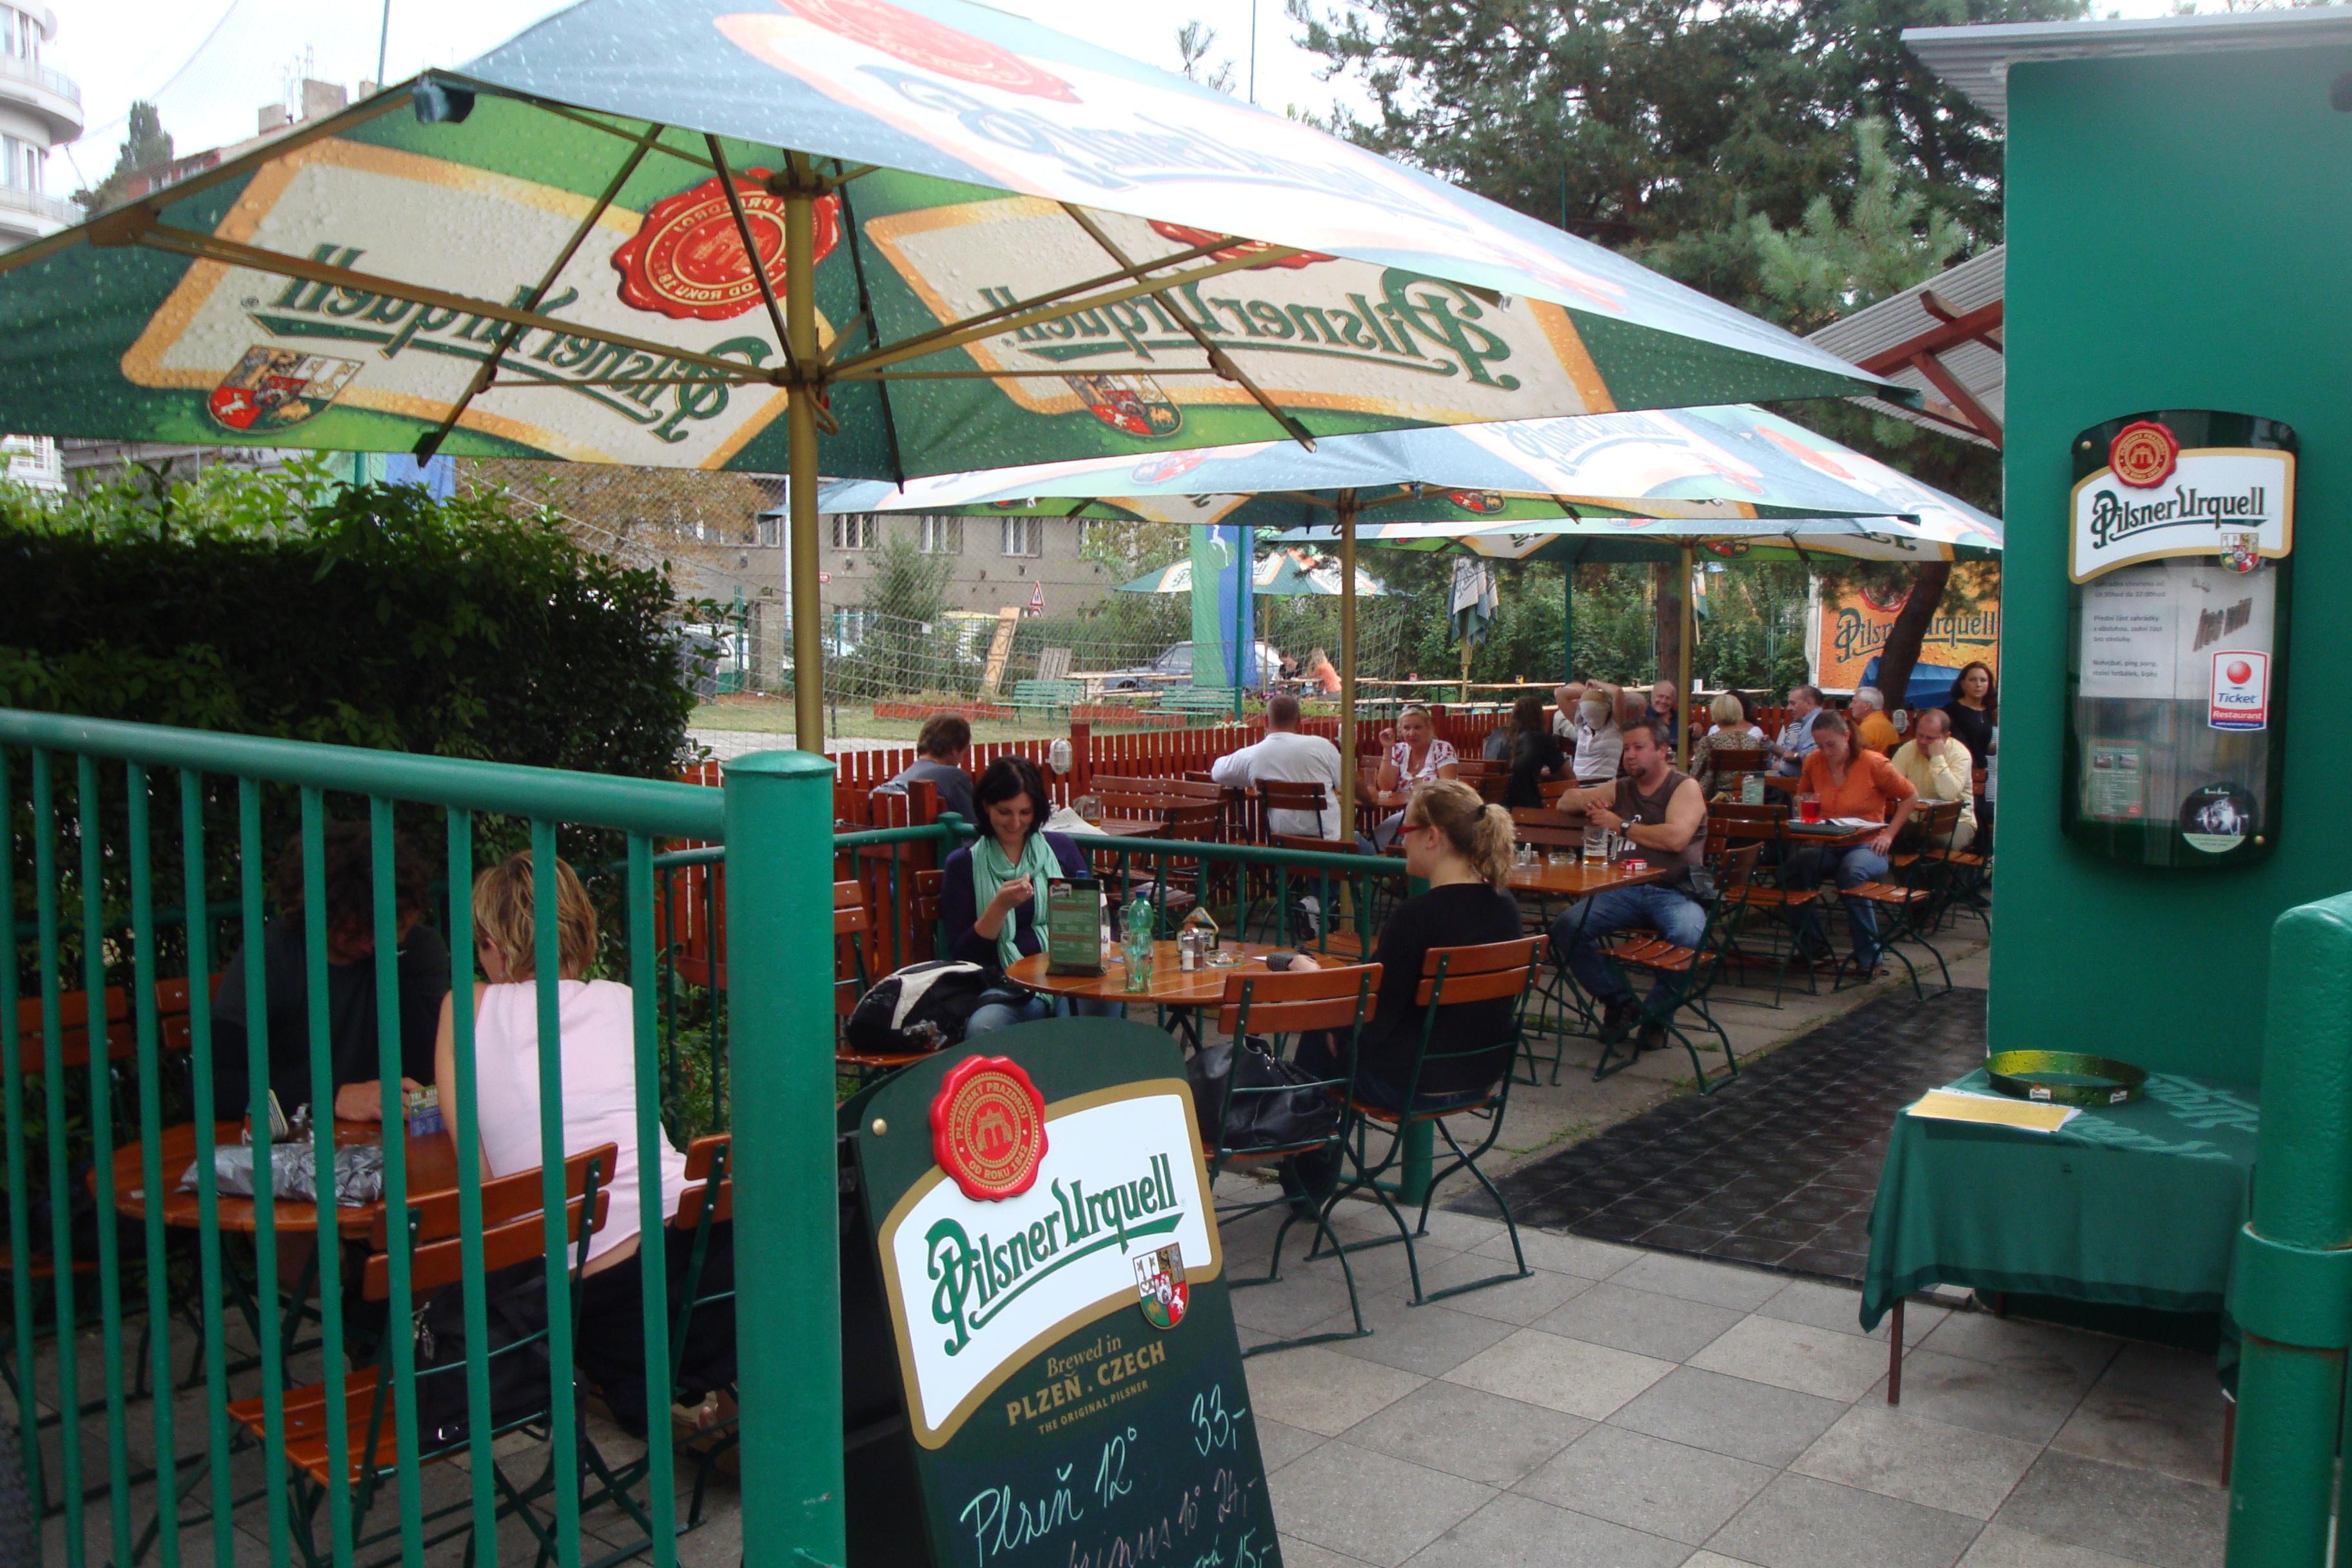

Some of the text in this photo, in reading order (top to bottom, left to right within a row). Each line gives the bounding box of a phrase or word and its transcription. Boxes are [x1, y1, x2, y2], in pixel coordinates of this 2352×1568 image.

[2090, 484, 2265, 549] Pilsner Urquell
[1925, 611, 1998, 649] rquell
[2213, 710, 2262, 720] Restaurant
[2218, 692, 2257, 703] Ticket
[956, 1083, 1029, 1139] PLZEŇSKÝ PRAZDROJ
[968, 1144, 1029, 1179] OD ROKU 1842
[924, 1153, 1178, 1357] Pilsner Urquell
[1006, 1340, 1166, 1427] PLZEŇ CZECH
[1047, 1334, 1122, 1378] Brewed in
[1038, 1379, 1149, 1435] THE ORIGINAL PILSNER
[959, 1462, 1084, 1568] Plzeň
